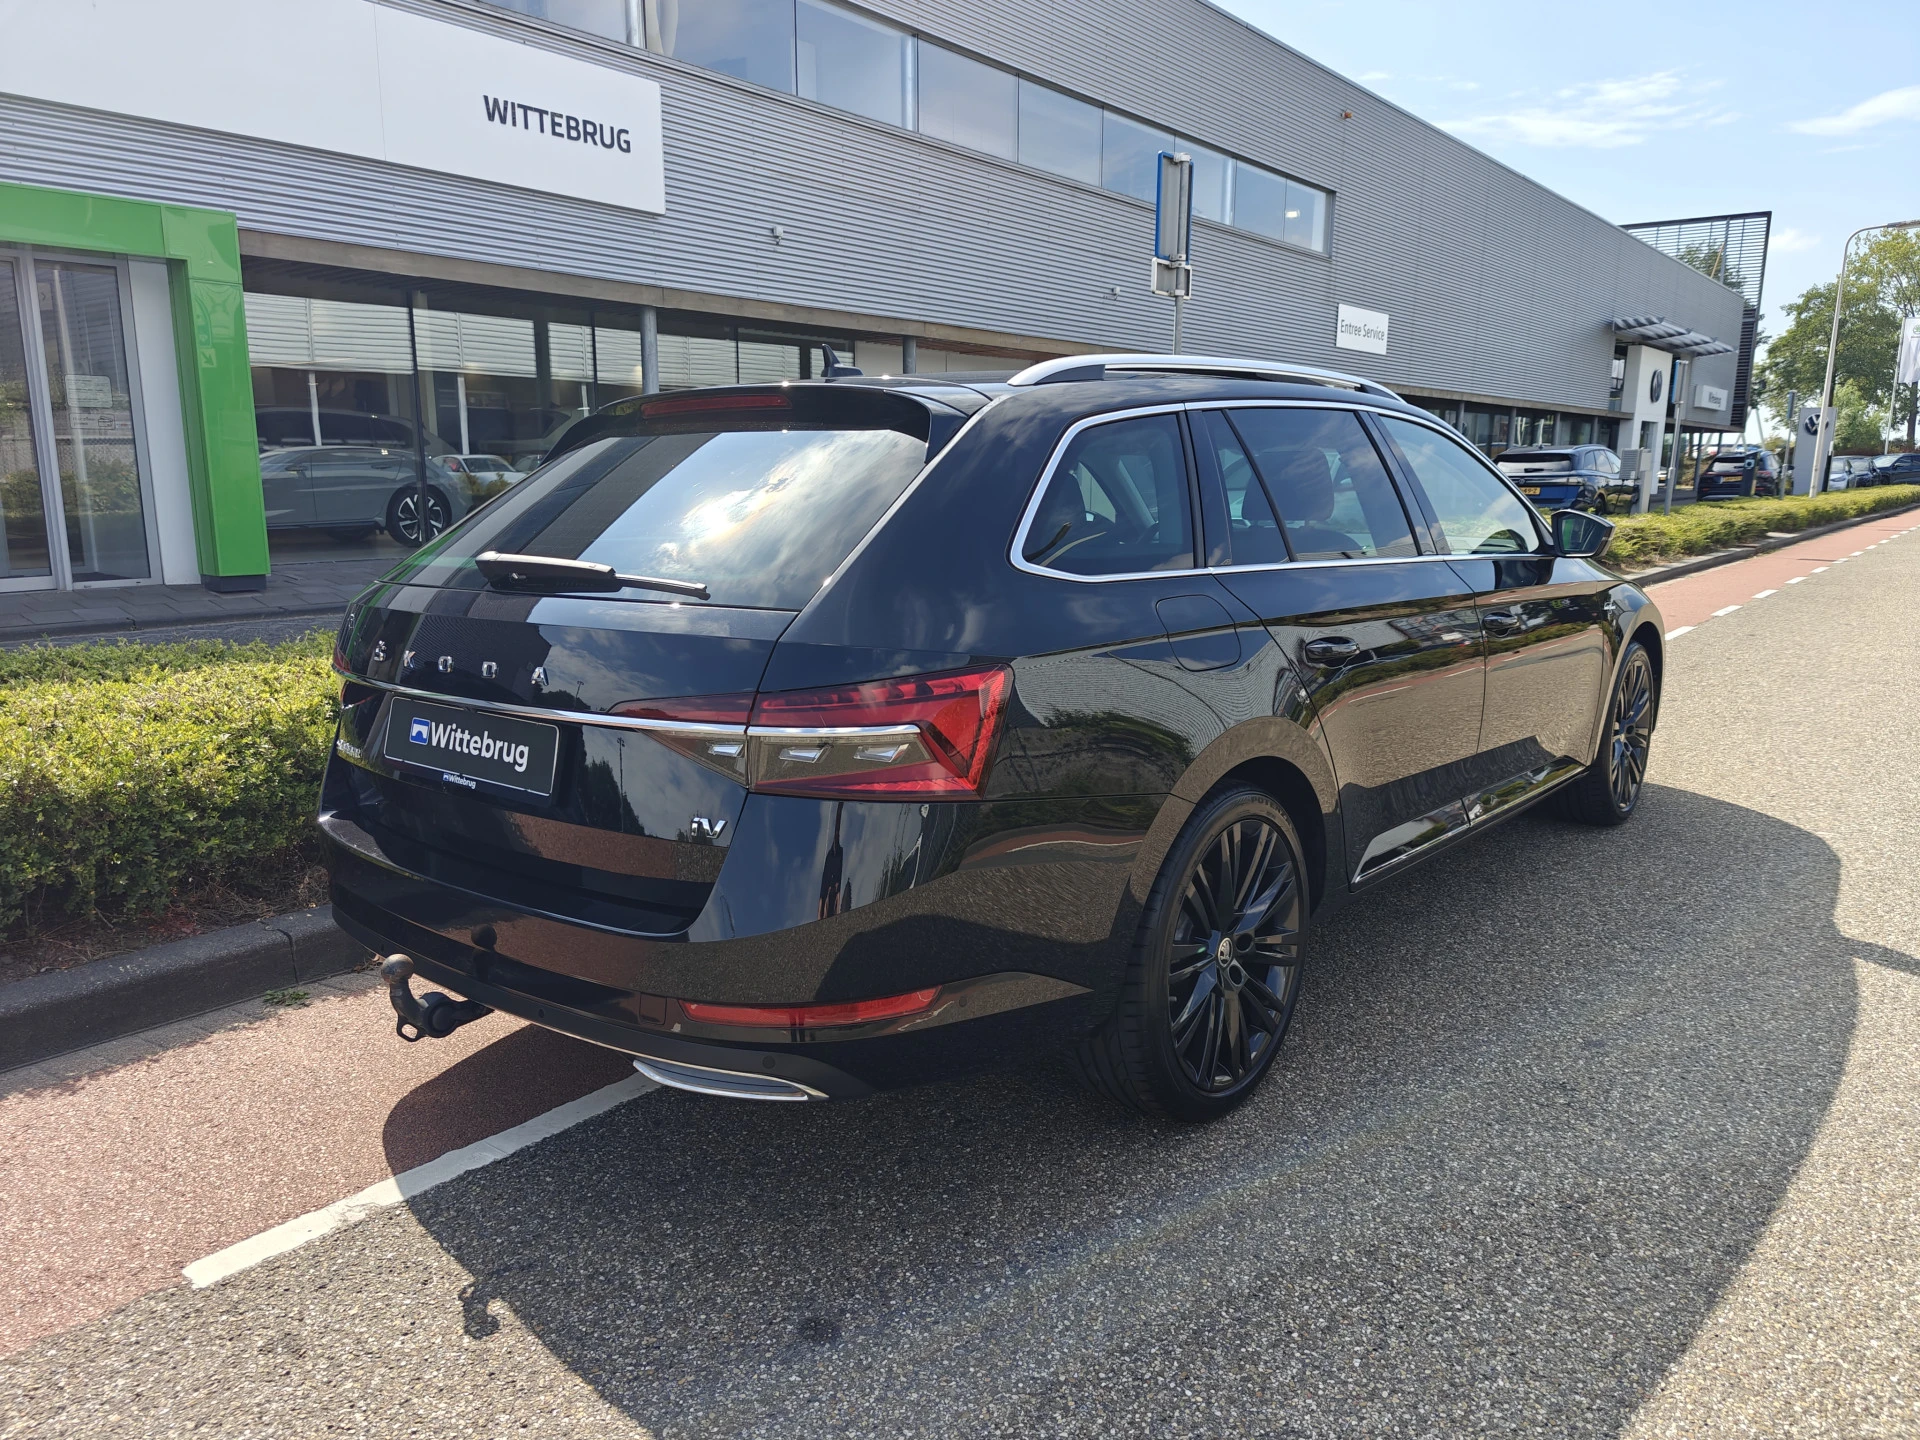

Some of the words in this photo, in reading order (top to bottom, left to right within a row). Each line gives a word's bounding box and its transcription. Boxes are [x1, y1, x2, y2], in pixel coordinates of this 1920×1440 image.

[482, 94, 632, 154] WITTEBRUG
[1340, 319, 1362, 337] Entree
[1362, 323, 1385, 342] Service
[430, 721, 530, 773] Wittebrug
[448, 773, 477, 790] Wittebrug
